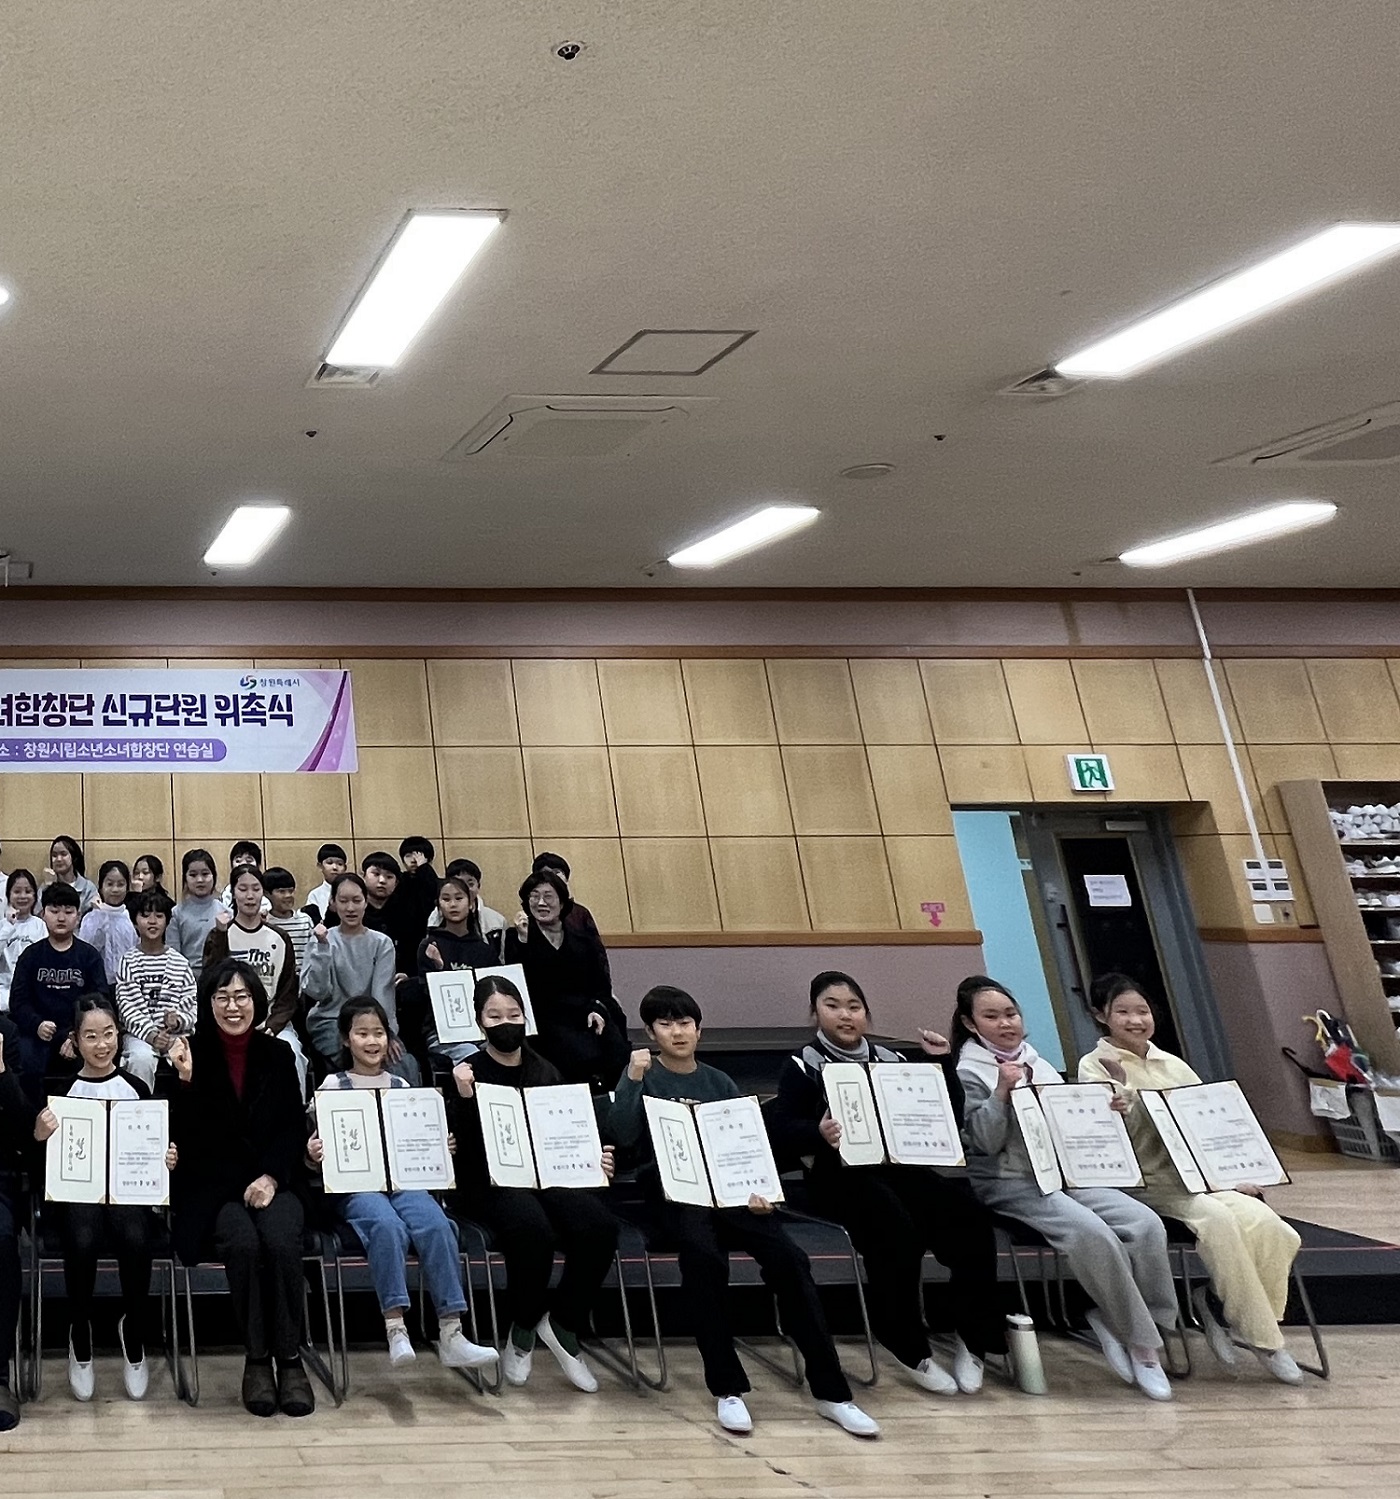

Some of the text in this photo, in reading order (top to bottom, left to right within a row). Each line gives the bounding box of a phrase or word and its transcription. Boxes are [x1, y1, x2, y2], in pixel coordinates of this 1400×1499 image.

[260, 678, 300, 687] 창원특례시
[101, 693, 208, 728] 신규단원
[214, 692, 294, 728] 위촉식
[23, 741, 171, 760] 창원시립소년소녀합창단
[173, 741, 214, 760] 연습실
[249, 948, 271, 962] The
